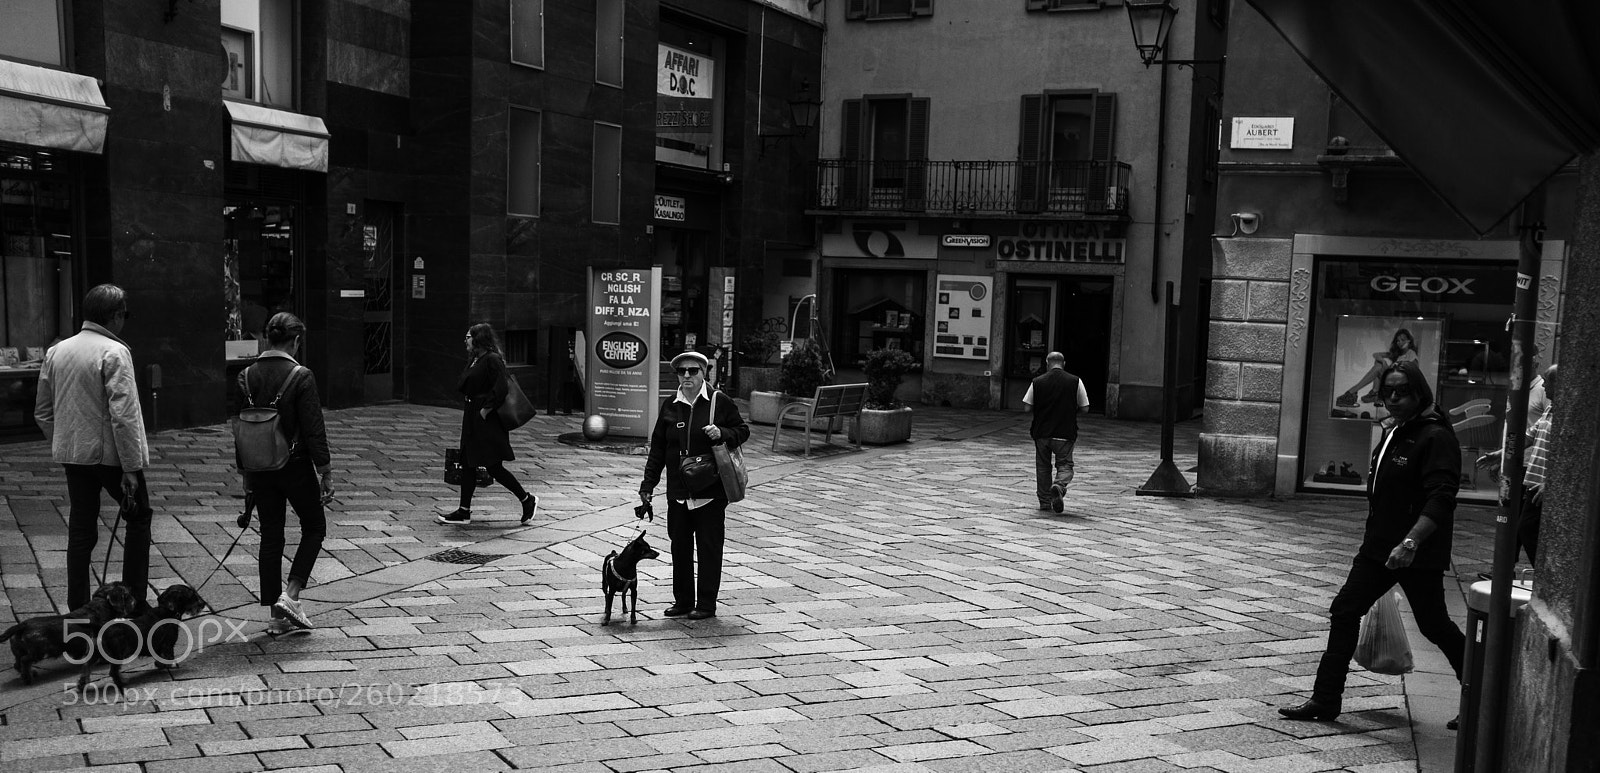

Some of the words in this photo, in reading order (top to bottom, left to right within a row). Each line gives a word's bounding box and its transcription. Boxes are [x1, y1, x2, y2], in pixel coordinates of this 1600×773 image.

[664, 50, 700, 77] AFFARI
[655, 208, 685, 220] KASALINGO
[1022, 221, 1100, 240] OTTICA
[997, 240, 1123, 263] OSTINELLI
[1370, 275, 1476, 295] GEOX
[609, 295, 619, 304] FA
[621, 295, 634, 305] LA
[603, 340, 639, 352] ENGLISH
[604, 350, 637, 361] CENTRE
